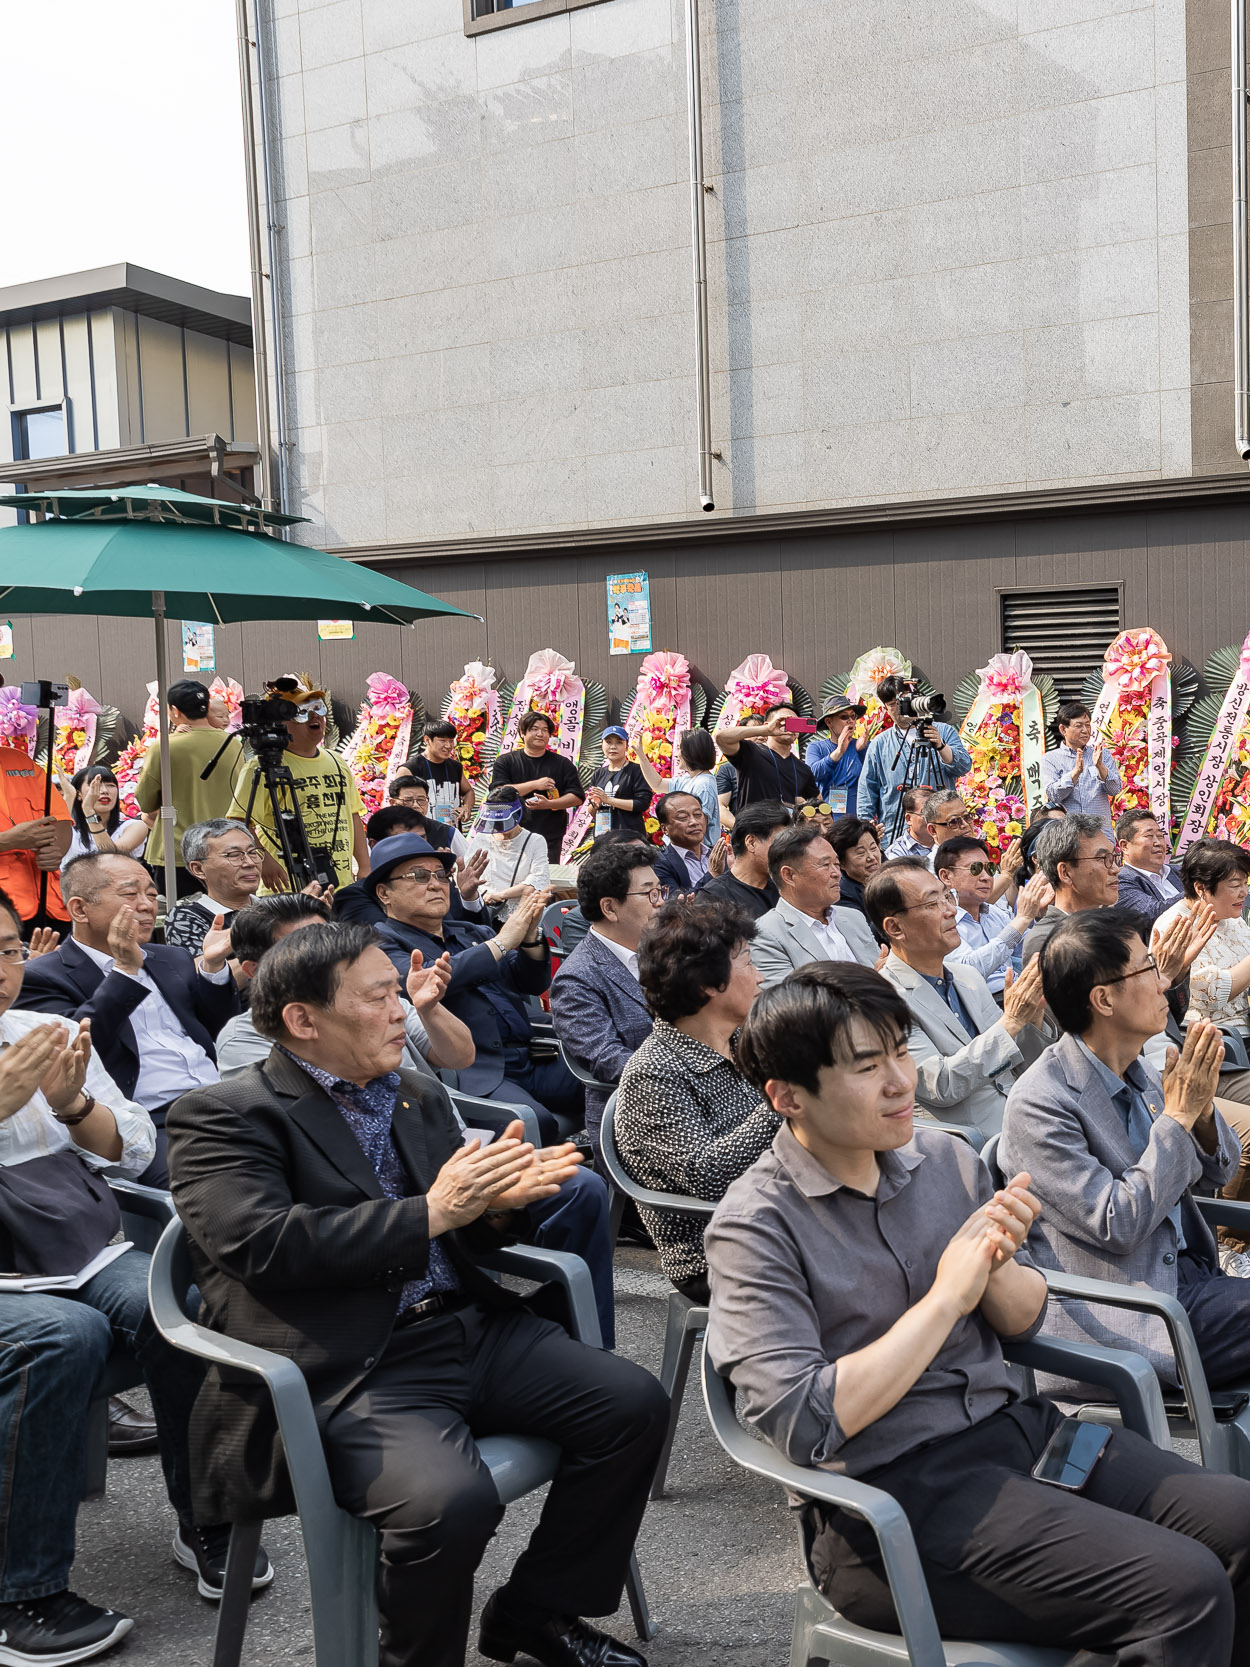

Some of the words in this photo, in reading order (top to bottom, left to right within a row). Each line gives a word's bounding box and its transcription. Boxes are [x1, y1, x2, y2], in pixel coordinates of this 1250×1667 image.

[563, 700, 579, 732] 앵콜
[1089, 702, 1111, 748] 연서시
[1152, 696, 1167, 711] 축
[1207, 683, 1250, 769] 방신전통시장
[1026, 720, 1040, 746] 축
[1152, 716, 1168, 807] 중곡제일시장
[1187, 774, 1219, 834] 상인회장
